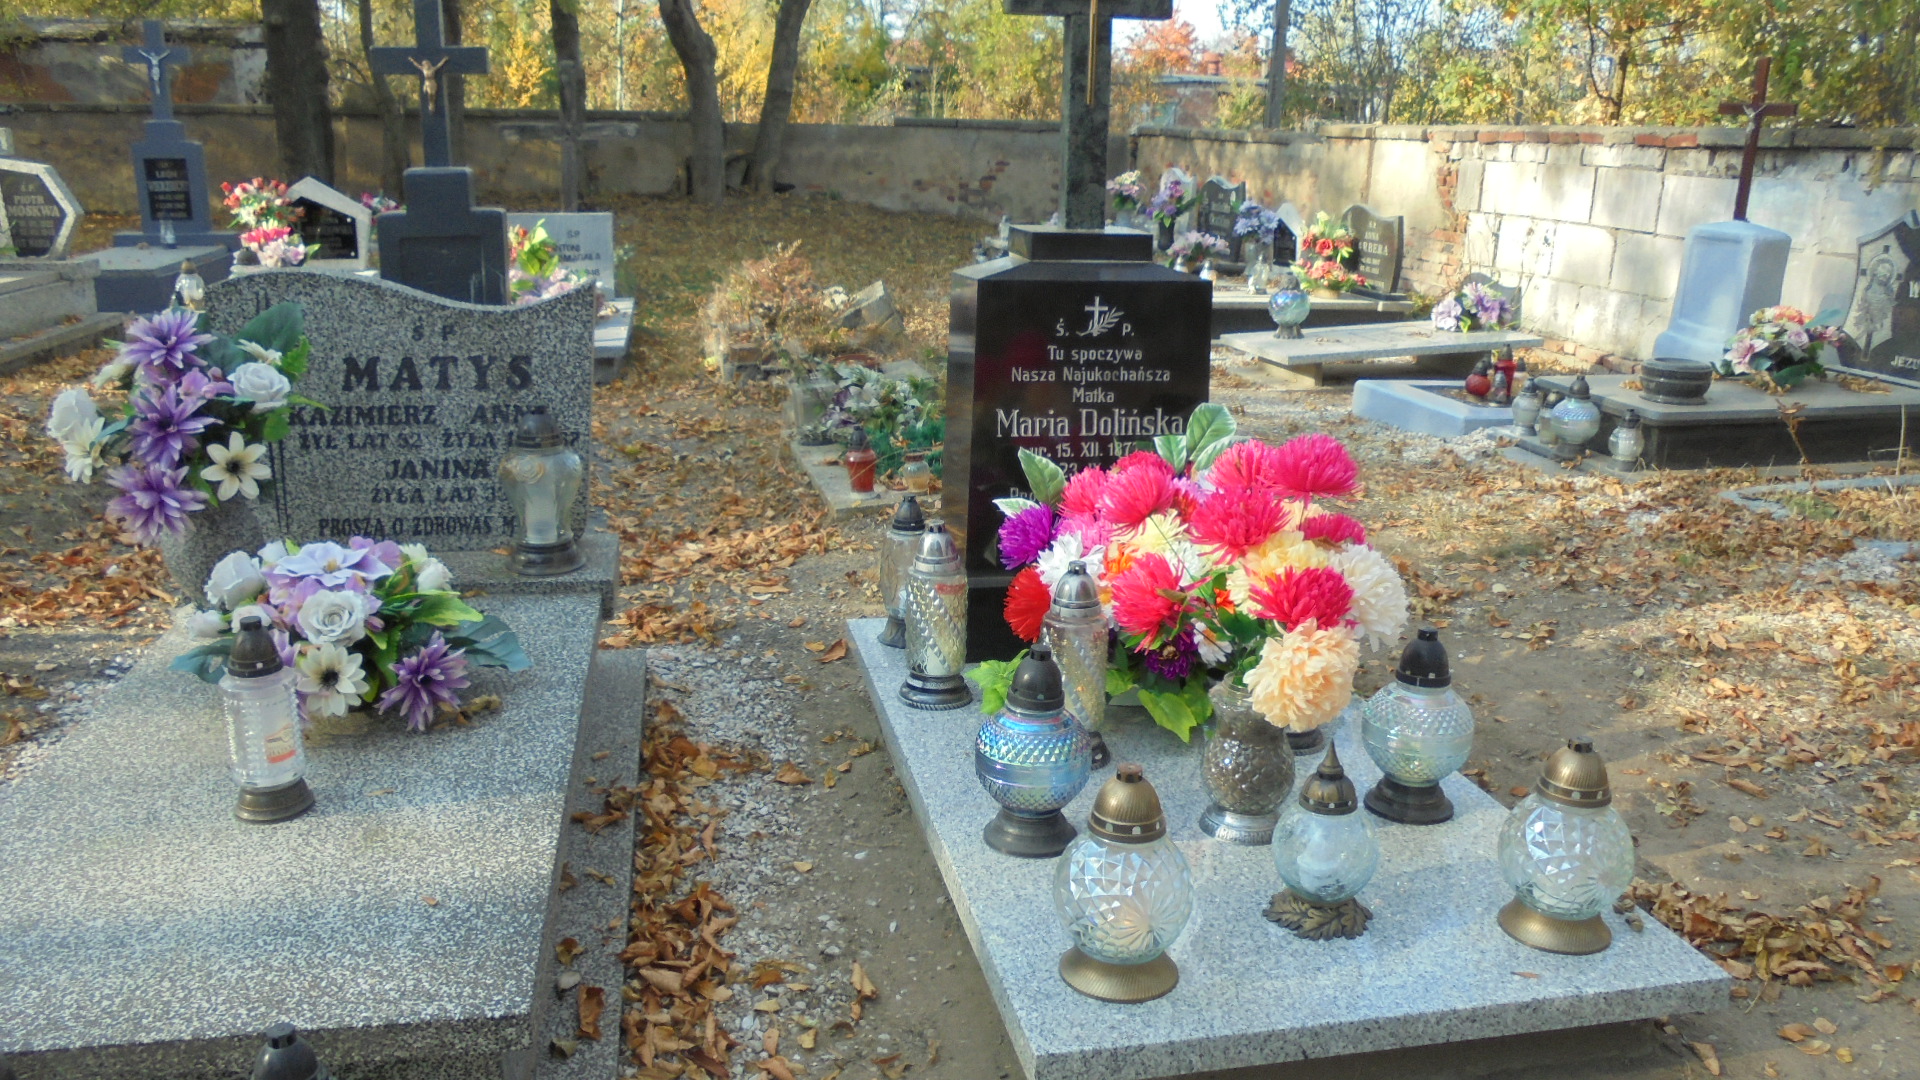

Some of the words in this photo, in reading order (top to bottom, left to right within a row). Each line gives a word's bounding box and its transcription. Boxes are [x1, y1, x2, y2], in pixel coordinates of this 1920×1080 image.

[14, 195, 45, 204] PIOTR
[7, 205, 60, 217] MOSKWA
[1056, 318, 1069, 337] Ś.
[1122, 322, 1135, 337] P.
[1047, 345, 1064, 361] Tu
[1071, 349, 1143, 364] spoczywa
[342, 354, 533, 392] MATYS
[1011, 366, 1056, 382] Nasza
[1063, 366, 1171, 385] Najukochańsza
[1072, 387, 1115, 403] Matka
[287, 404, 436, 427] KAZIMIERZ
[996, 408, 1070, 437] Maria
[1079, 406, 1184, 437] Dolińska
[348, 432, 389, 449] LAT
[1056, 442, 1075, 458] 15.
[1080, 442, 1103, 458] XII.
[386, 458, 494, 480] JANINA
[435, 485, 479, 503] LAT
[393, 517, 404, 536] O
